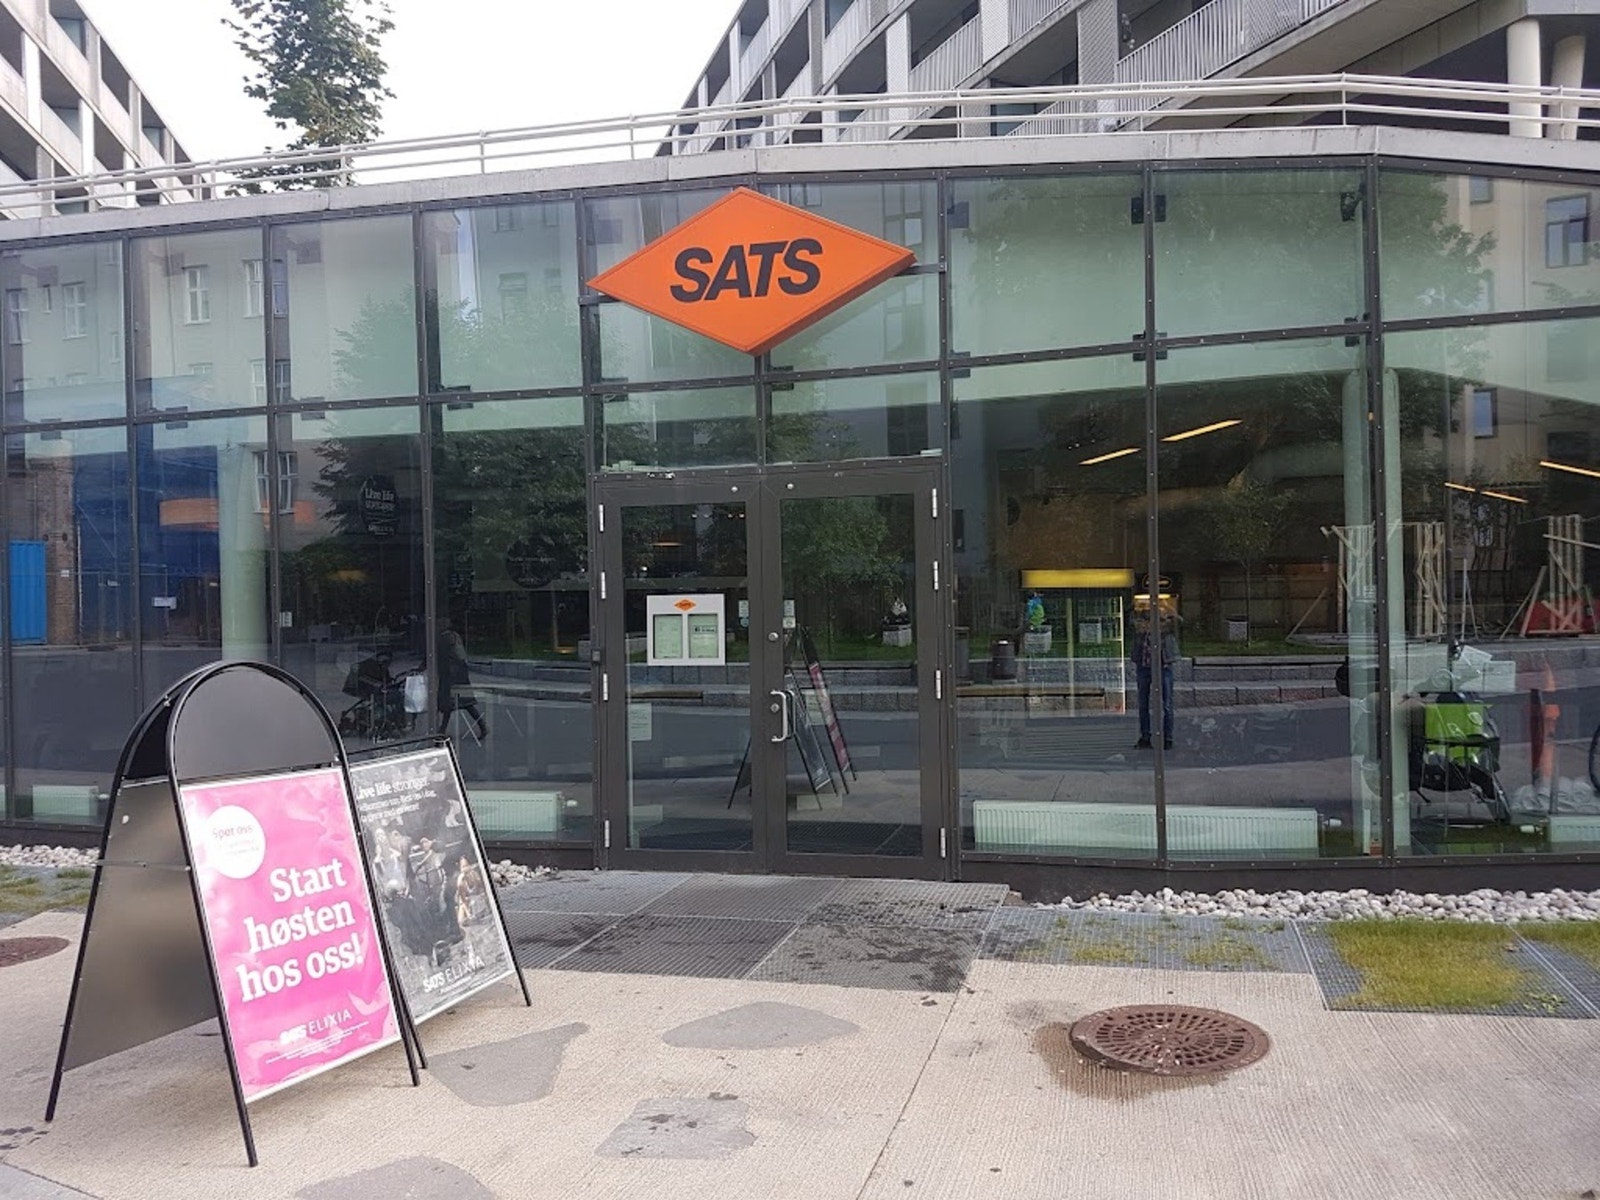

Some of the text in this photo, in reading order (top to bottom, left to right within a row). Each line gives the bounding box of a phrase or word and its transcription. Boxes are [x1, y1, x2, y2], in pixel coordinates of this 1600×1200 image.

[670, 238, 823, 303] SATS
[374, 781, 393, 796] life
[269, 858, 348, 902] Start
[243, 900, 356, 954] høsten
[235, 932, 364, 1003] hos oss!
[308, 1008, 352, 1035] ELIXIA
